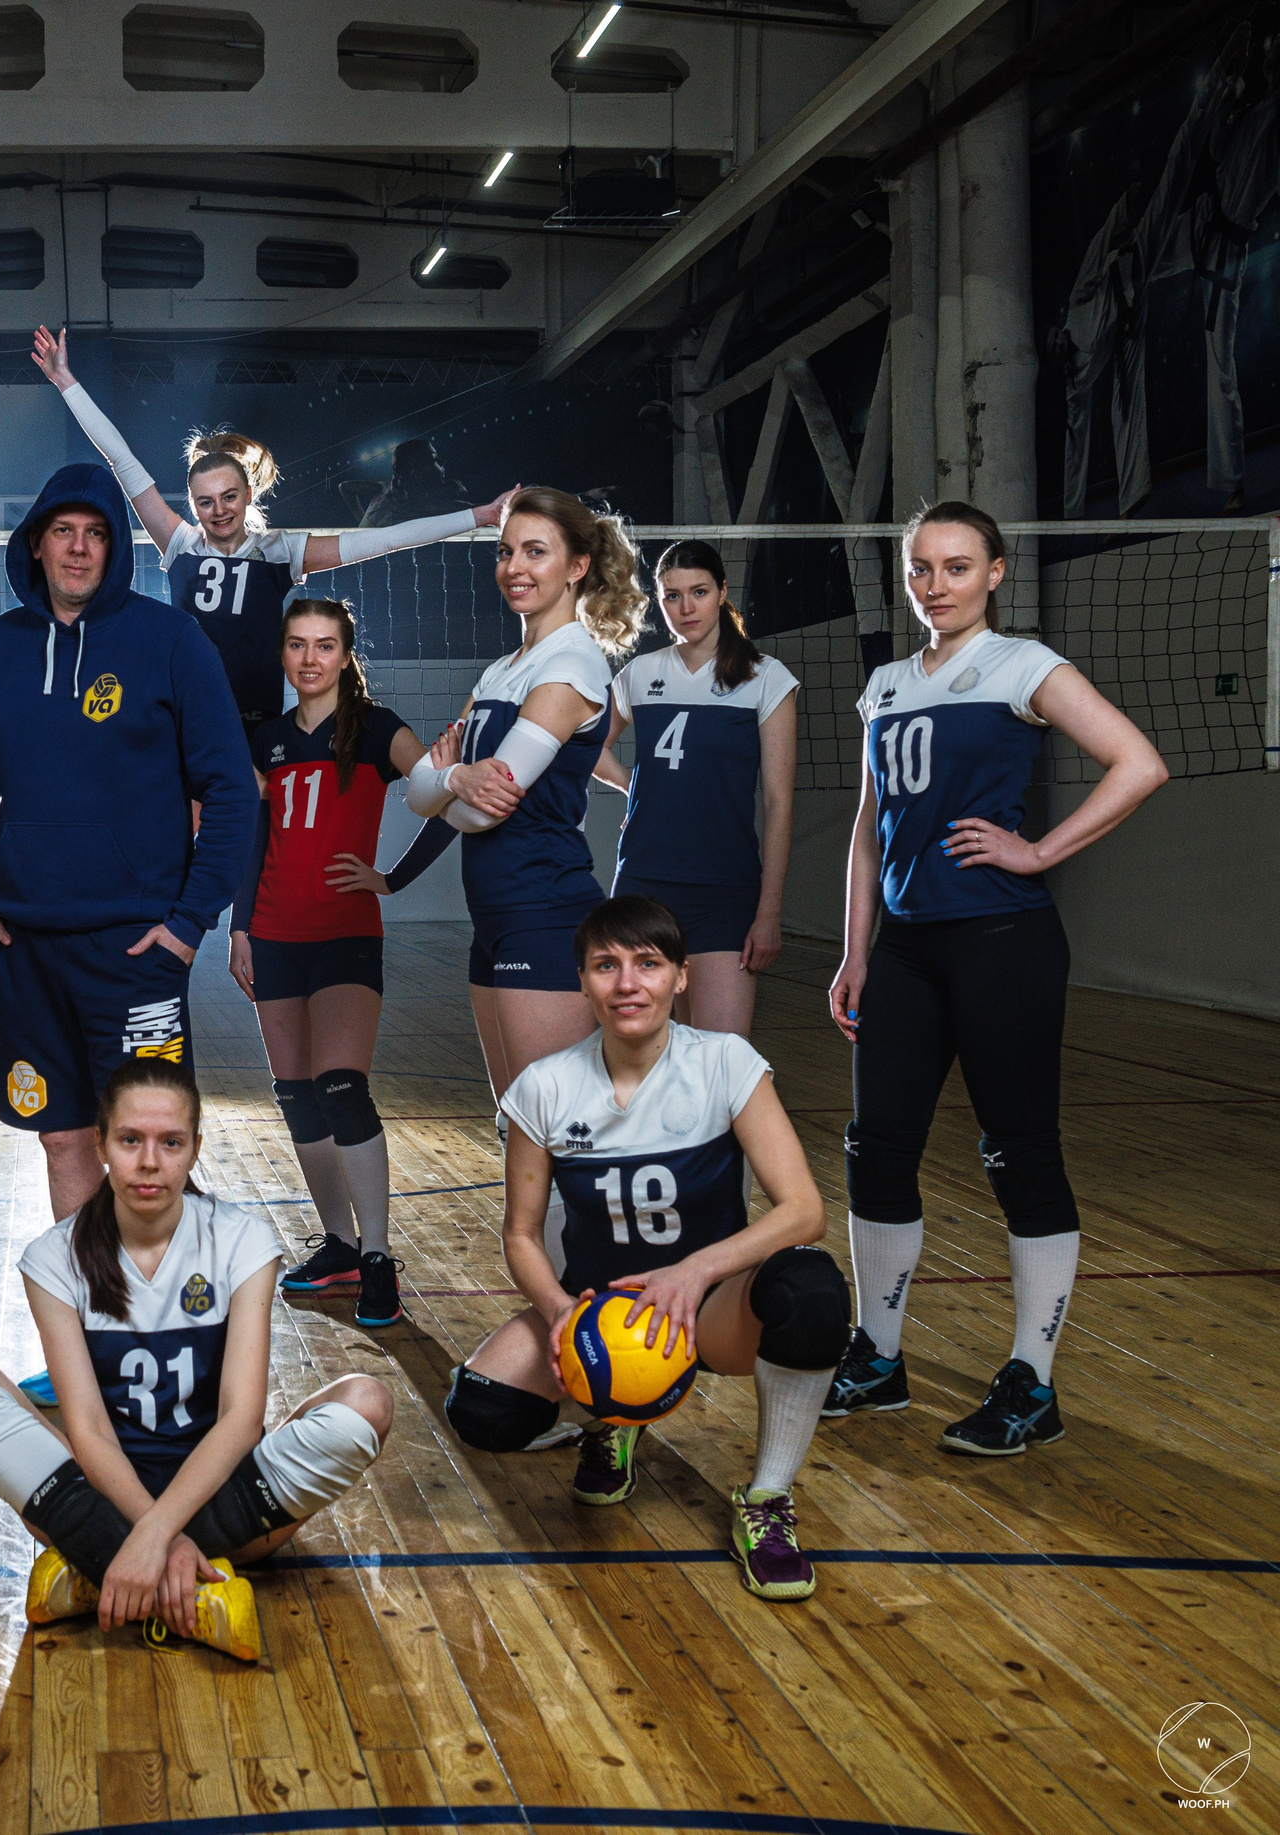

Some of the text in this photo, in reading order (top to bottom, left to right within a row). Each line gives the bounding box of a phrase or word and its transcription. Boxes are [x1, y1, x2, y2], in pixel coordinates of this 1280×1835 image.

[195, 558, 250, 615] 31
[654, 711, 690, 770] 4
[881, 716, 934, 796] 10
[281, 769, 323, 829] 11
[122, 997, 182, 1053] TEAM
[566, 1139, 594, 1150] errea
[595, 1164, 682, 1245] 18
[580, 1331, 599, 1366] V300W
[116, 1346, 195, 1432] 31
